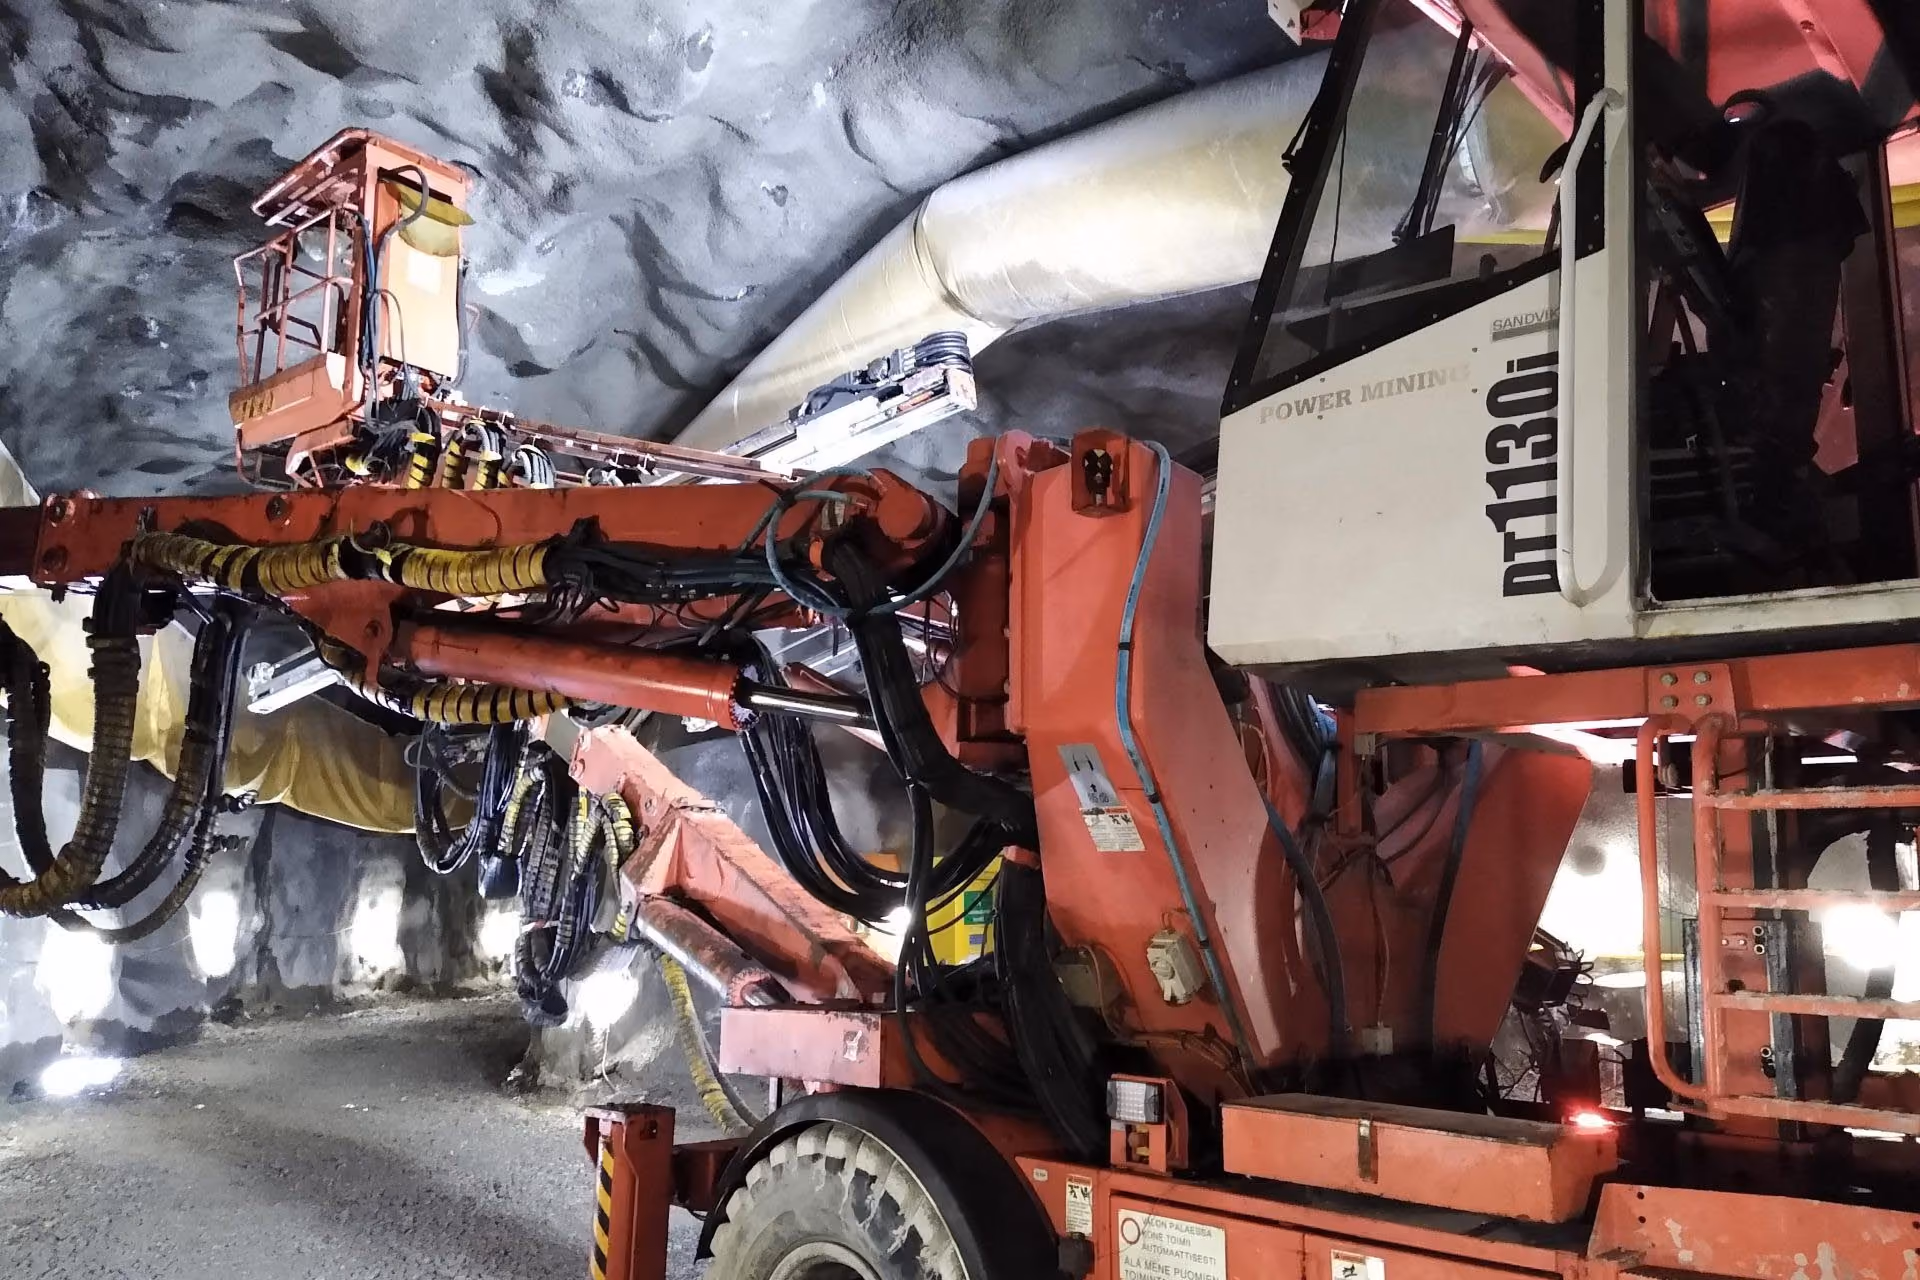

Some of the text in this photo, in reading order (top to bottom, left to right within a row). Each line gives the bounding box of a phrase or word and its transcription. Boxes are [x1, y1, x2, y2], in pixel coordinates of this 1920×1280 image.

[1492, 306, 1560, 332] SANDVIK
[1258, 364, 1471, 425] POWER MINING
[1485, 350, 1562, 598] DT1130i
[1144, 1260, 1172, 1277] MENE
